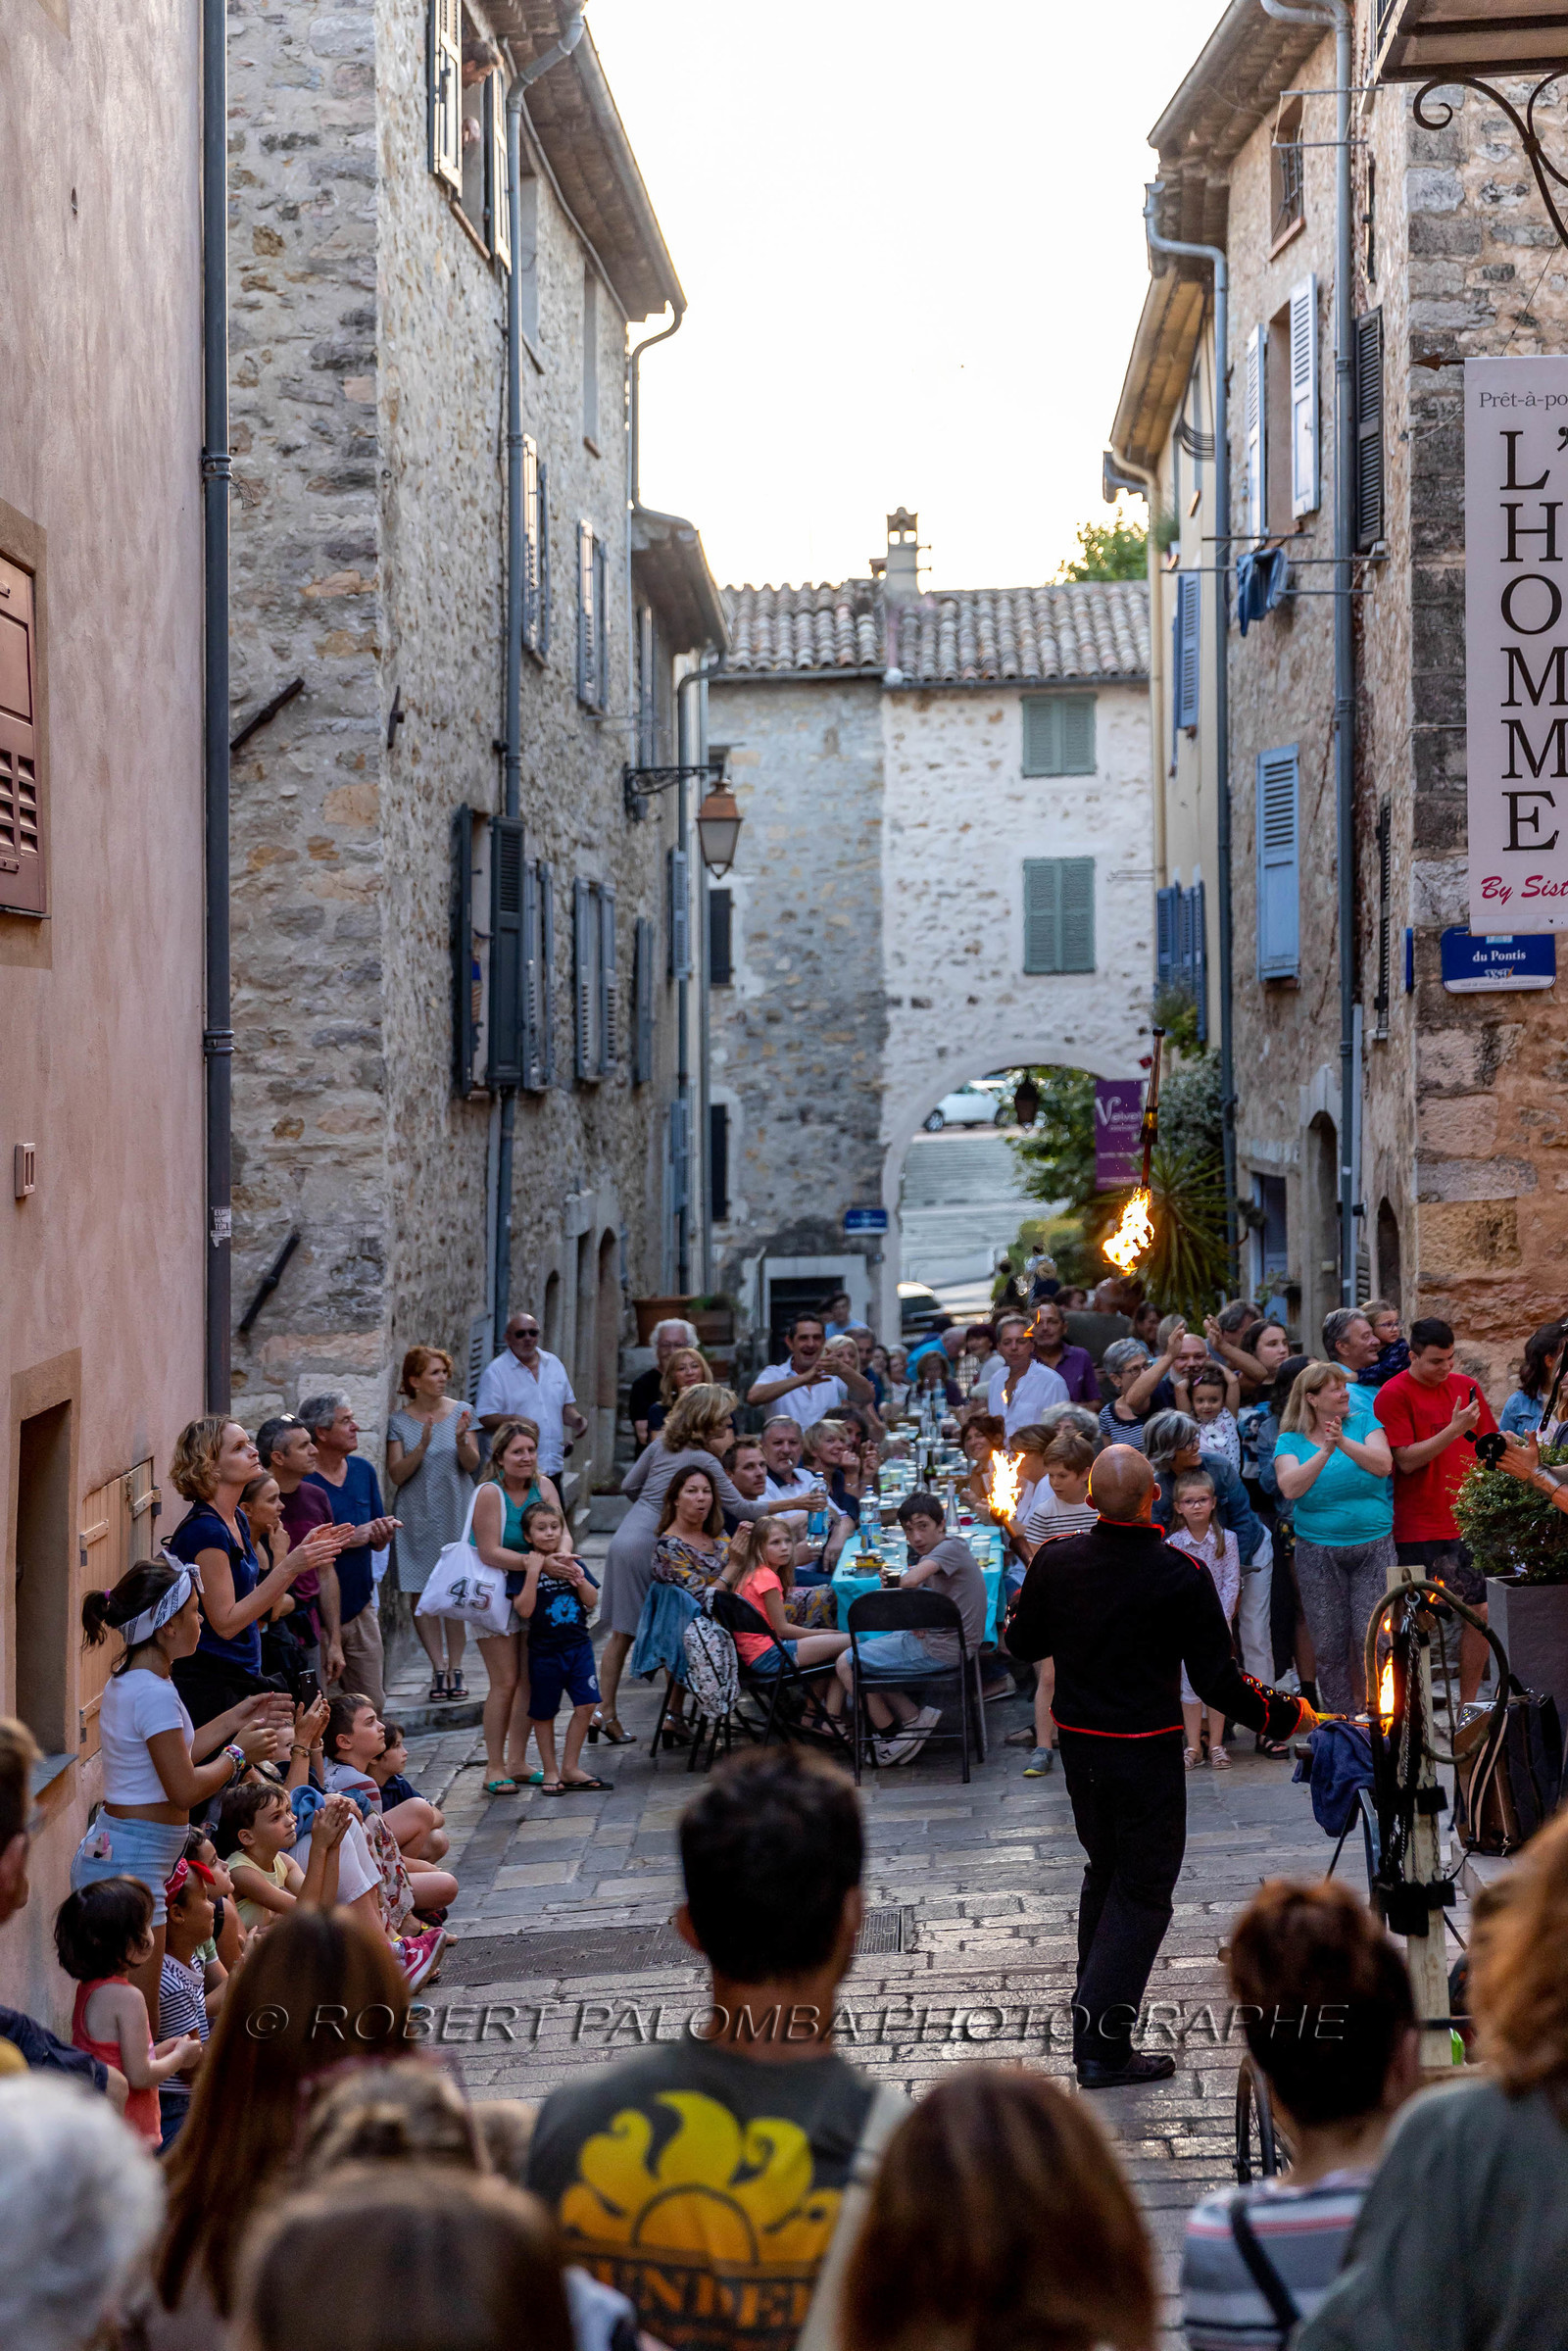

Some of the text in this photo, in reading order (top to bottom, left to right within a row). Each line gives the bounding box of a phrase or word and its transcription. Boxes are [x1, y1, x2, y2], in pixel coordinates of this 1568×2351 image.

[1480, 875, 1514, 906] By
[1472, 949, 1527, 962] du Pontis
[446, 1576, 496, 1612] 45
